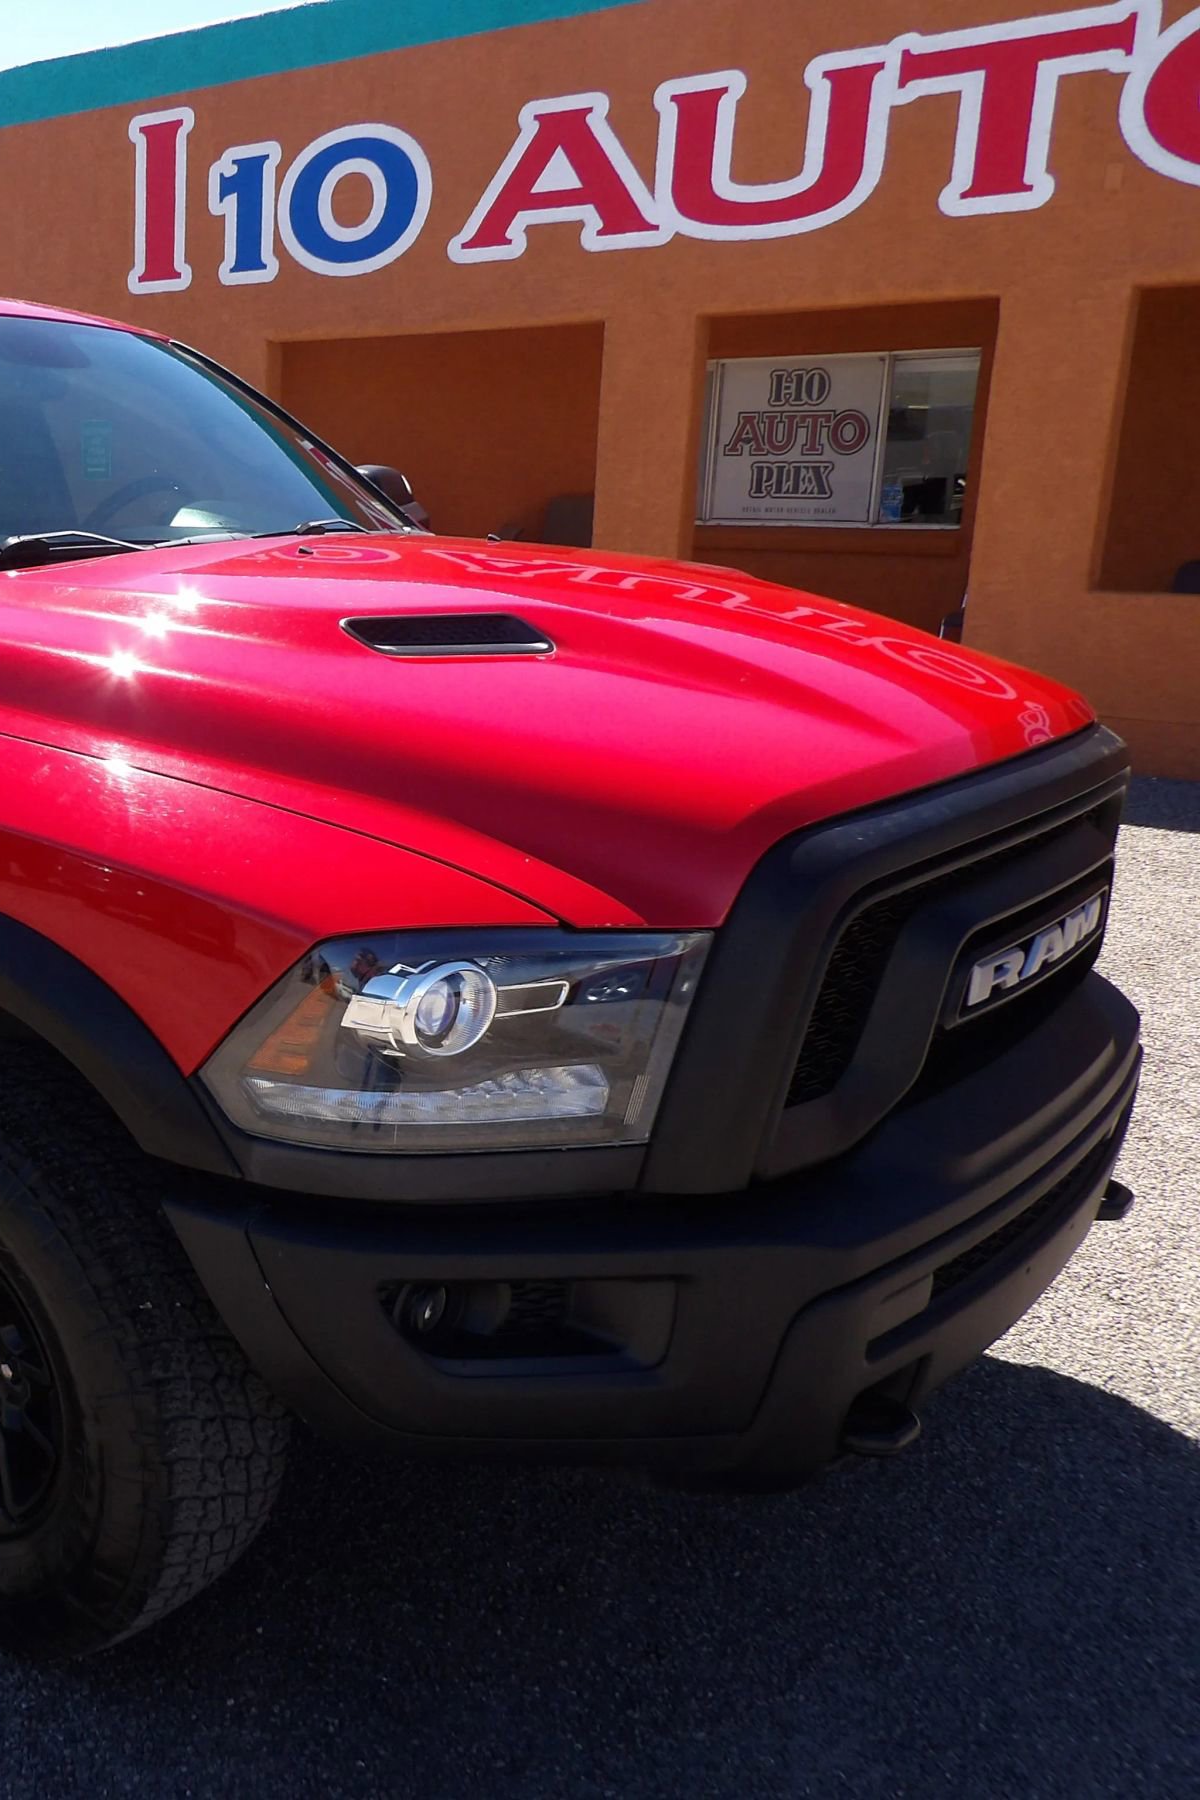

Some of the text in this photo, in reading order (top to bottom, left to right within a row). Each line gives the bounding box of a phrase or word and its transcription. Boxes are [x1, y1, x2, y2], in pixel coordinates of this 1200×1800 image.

[209, 123, 432, 285] 10
[724, 409, 870, 456] AUTO
[750, 461, 834, 499] PLEX
[967, 897, 1101, 1006] RAM
